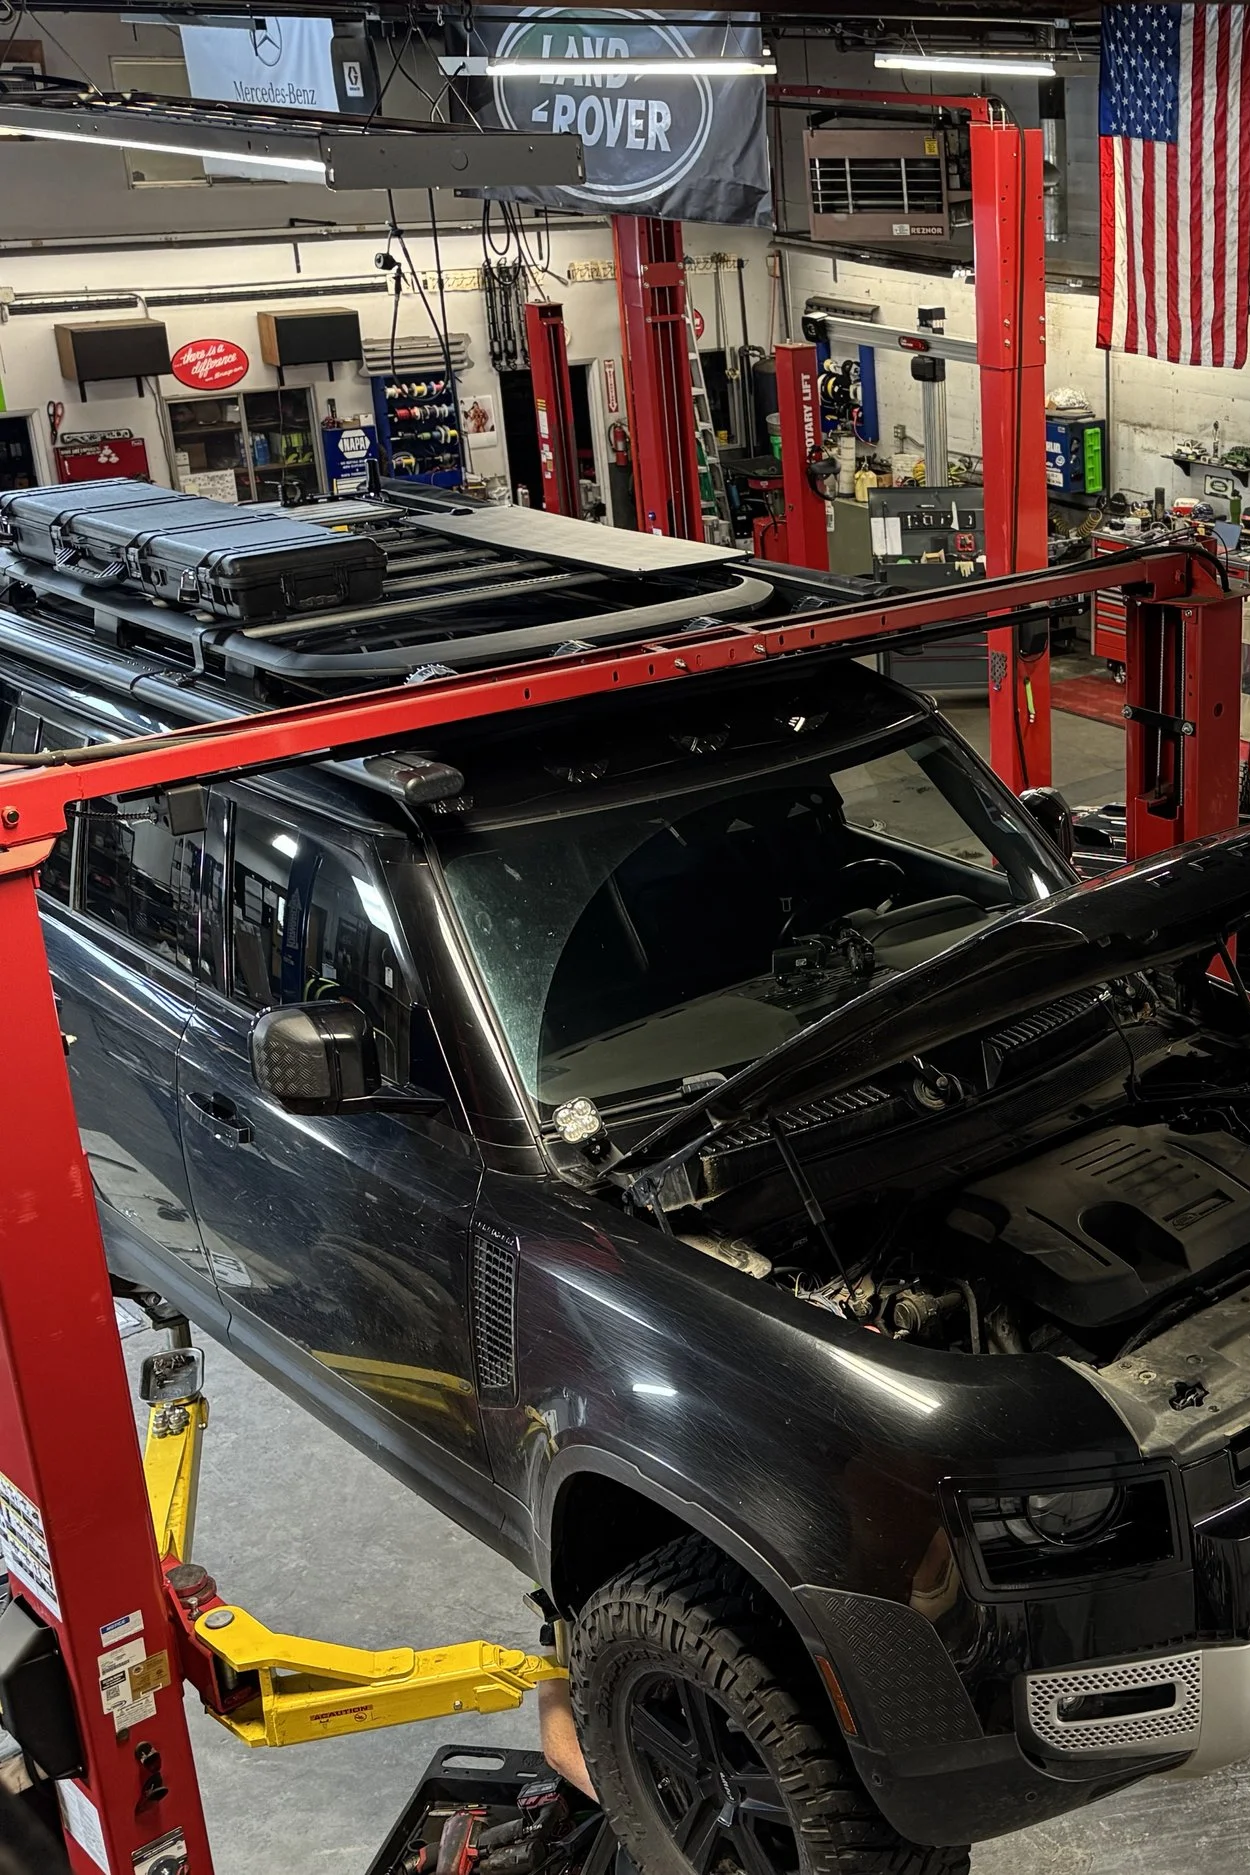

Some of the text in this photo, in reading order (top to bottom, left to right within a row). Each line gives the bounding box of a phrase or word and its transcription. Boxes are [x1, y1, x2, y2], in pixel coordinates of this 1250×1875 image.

[539, 35, 631, 89] LAND
[233, 81, 317, 105] Mercedes-Benz
[552, 94, 672, 152] ROVER
[910, 227, 943, 235] REZNOR
[801, 373, 812, 401] LIFT
[342, 436, 367, 452] NAPA
[106, 1618, 127, 1632] NOTICE
[319, 1705, 368, 1719] CAUTION
